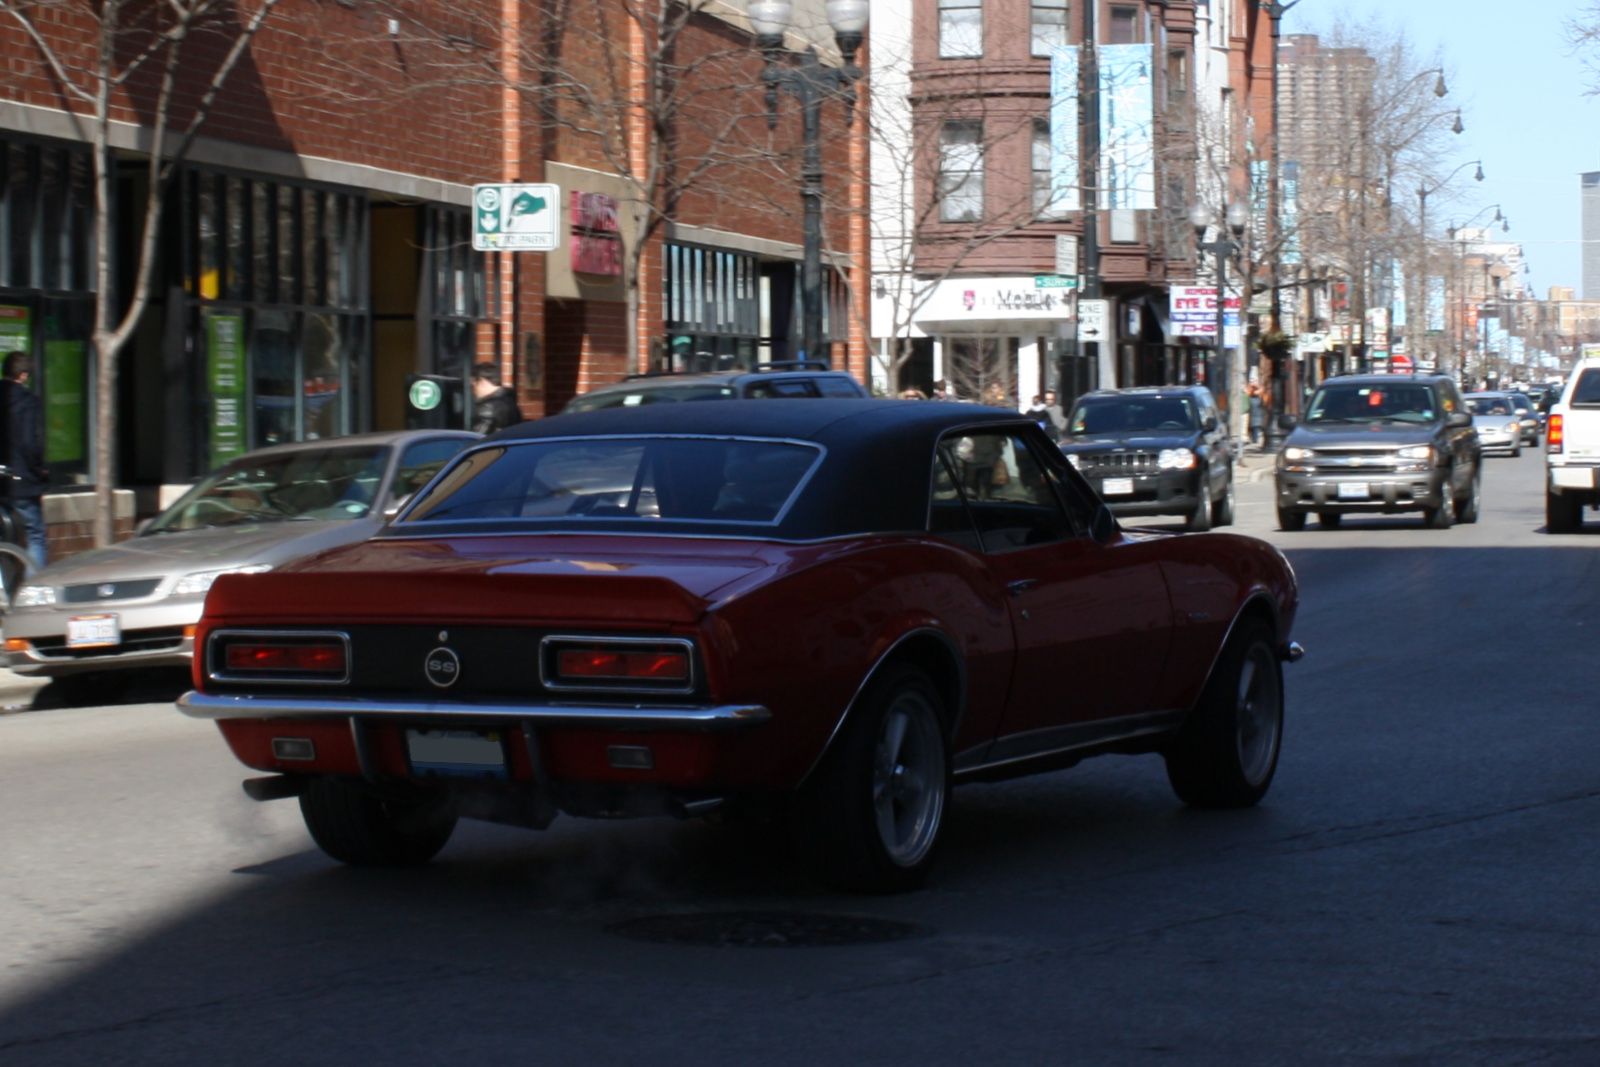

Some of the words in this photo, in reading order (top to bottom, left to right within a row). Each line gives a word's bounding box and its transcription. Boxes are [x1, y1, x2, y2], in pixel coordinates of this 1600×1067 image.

[1077, 304, 1101, 314] ONE
[1175, 298, 1200, 309] EYE
[1077, 316, 1101, 325] WAY
[418, 385, 434, 406] P
[429, 660, 455, 673] SS
